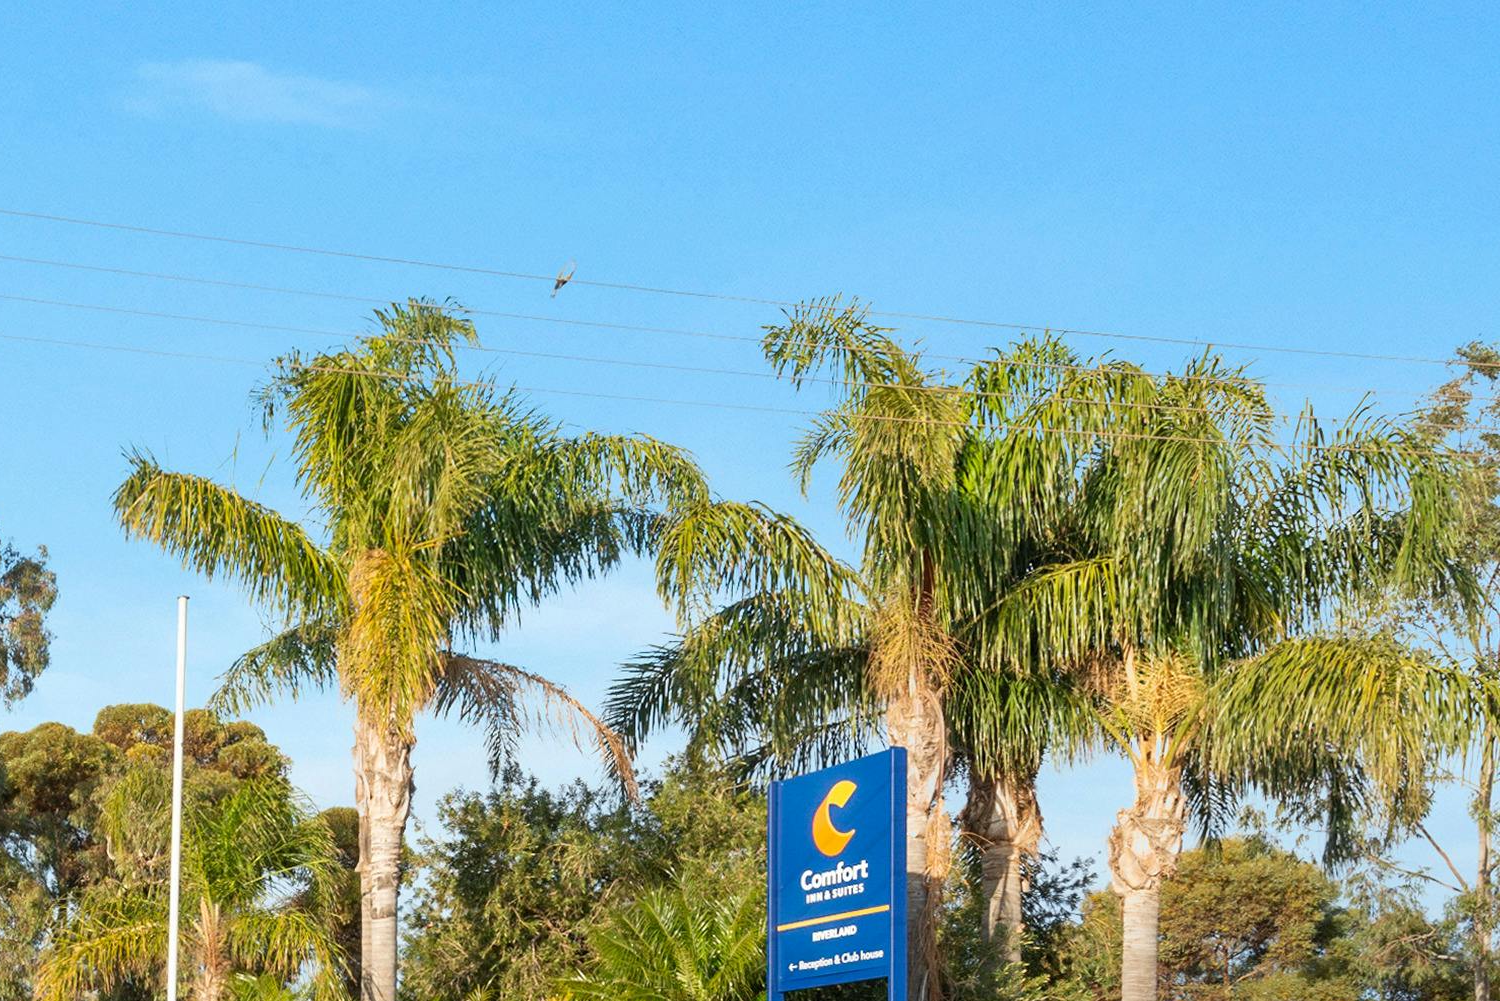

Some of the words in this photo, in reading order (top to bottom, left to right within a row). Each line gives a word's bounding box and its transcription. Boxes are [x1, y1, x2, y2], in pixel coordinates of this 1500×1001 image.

[800, 859, 869, 891] Comfort
[805, 891, 824, 905] INN
[823, 889, 832, 901] &
[831, 882, 865, 899] SUITES
[812, 924, 858, 942] RIVERLAND
[798, 957, 834, 971] Reception
[834, 954, 841, 965] &
[841, 951, 860, 964] Club
[860, 949, 884, 961] house
